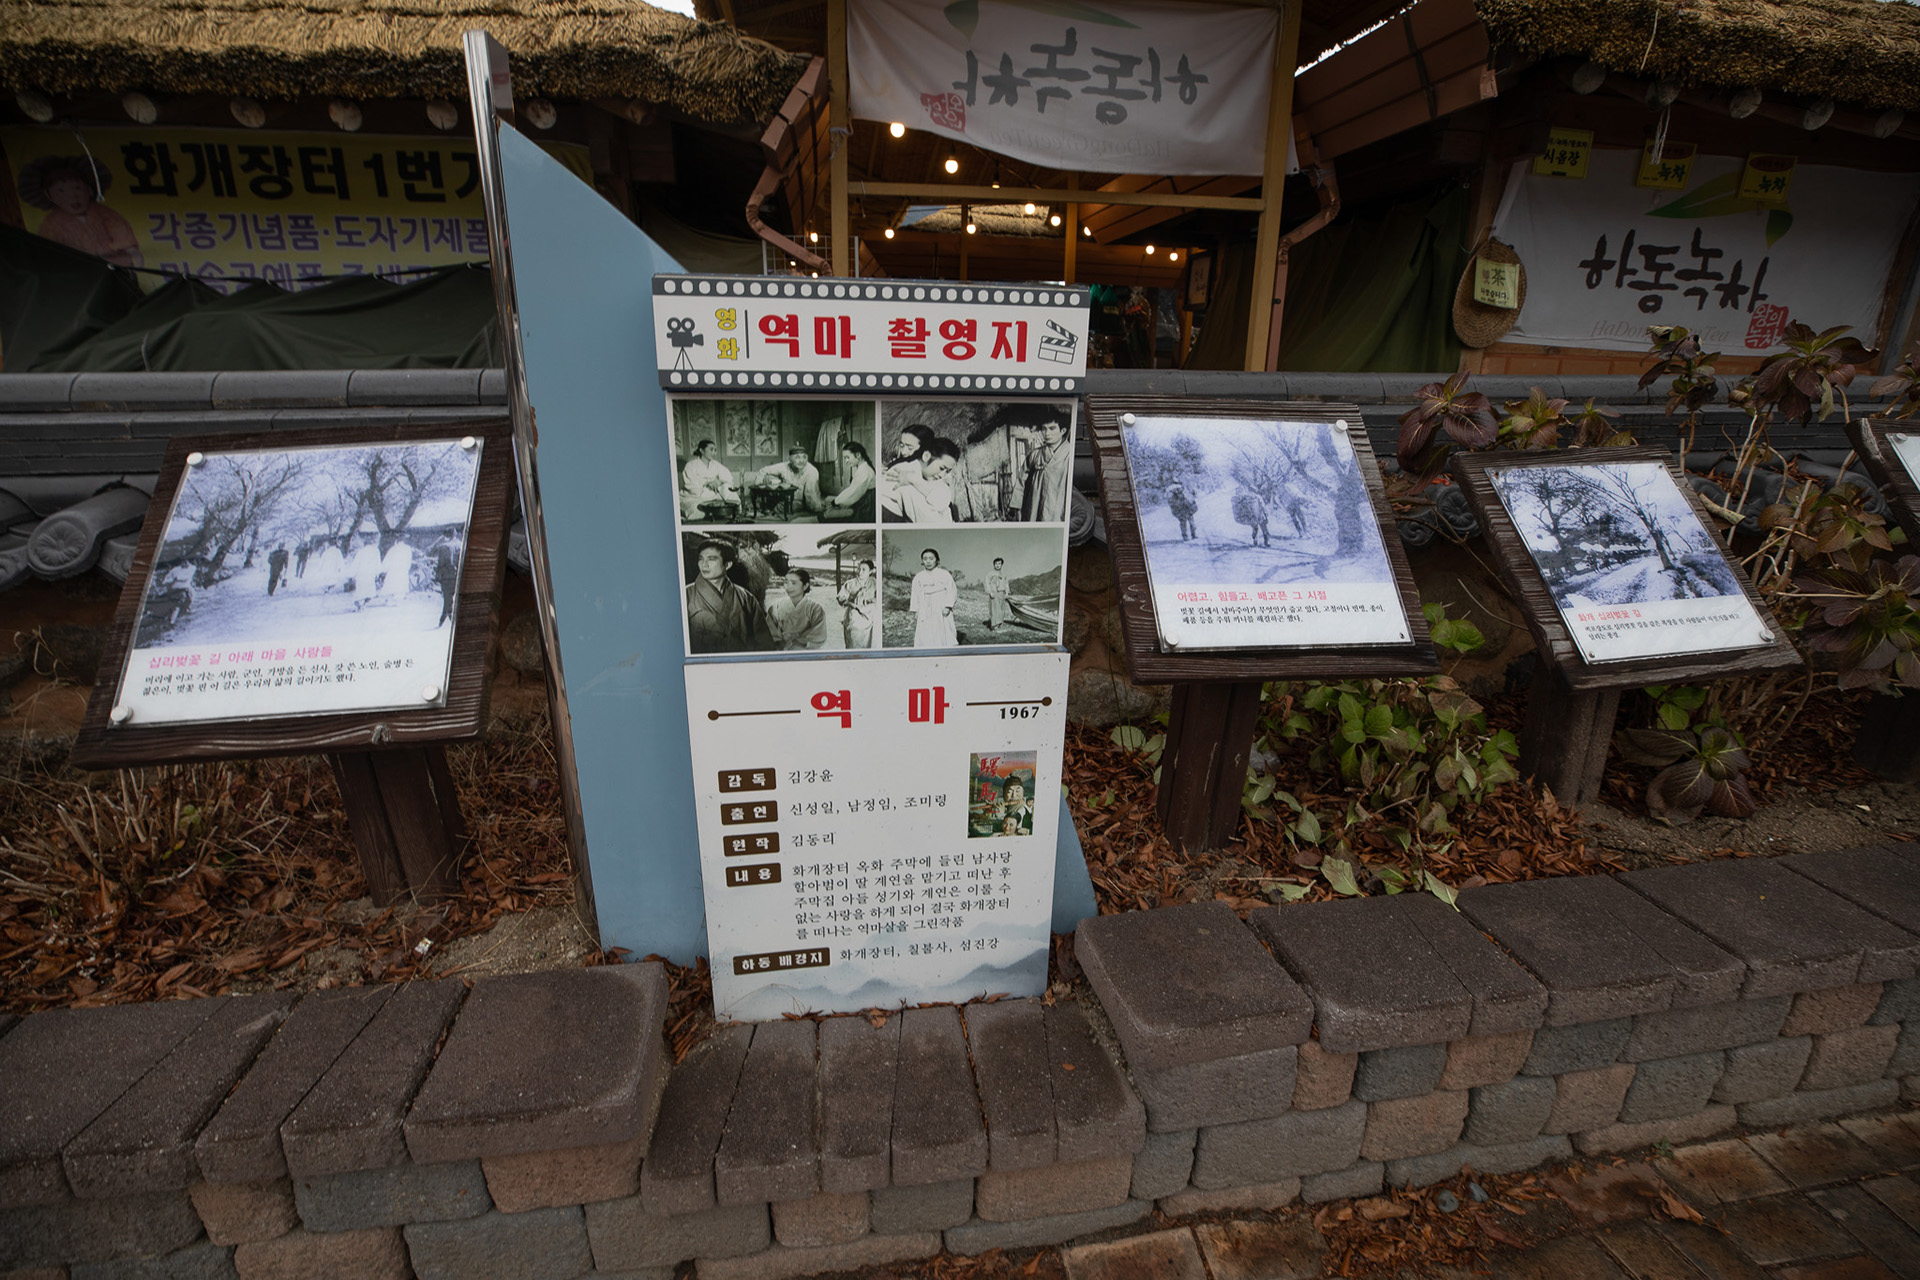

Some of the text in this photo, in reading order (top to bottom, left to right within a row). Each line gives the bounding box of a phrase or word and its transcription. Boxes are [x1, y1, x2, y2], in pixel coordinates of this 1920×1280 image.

[1544, 148, 1580, 166] 시음장
[121, 141, 352, 200] 화개장터
[1658, 162, 1685, 182] 녹차
[1758, 175, 1786, 194] 녹차
[1578, 227, 1771, 314] 하동녹차
[758, 313, 1029, 363] 역마 촬영지
[1177, 590, 1327, 602] 어렵고, 힘들고, 배고픈 그 시절
[149, 645, 333, 669] 십리벚꽃 길 아래 마을 사람들
[999, 706, 1041, 720] 1967
[788, 768, 834, 784] 김강윤
[790, 793, 948, 816] 신성일, 남정임, 조미령
[791, 832, 835, 847] 김동리
[792, 851, 1013, 877] 화개장터 옥화 주막에 들린 남사당
[793, 878, 849, 893] 할아범이
[855, 877, 868, 889] 딸
[921, 870, 961, 884] 맡기고
[967, 868, 993, 881] 떠난
[999, 867, 1012, 879] 후
[794, 894, 835, 909] 주막집
[842, 892, 869, 905] 아들
[875, 889, 915, 903] 성기와
[967, 883, 993, 896] 이룰
[999, 883, 1011, 895] 수
[795, 898, 1010, 925] 없는 사랑을 하게 되어 결국 화개장터
[796, 916, 964, 940] 를 떠나는 역마살을 그린작품
[742, 951, 823, 970] 하동 배경지
[840, 937, 1000, 961] 화개장터, 칠불사, 섬진강
